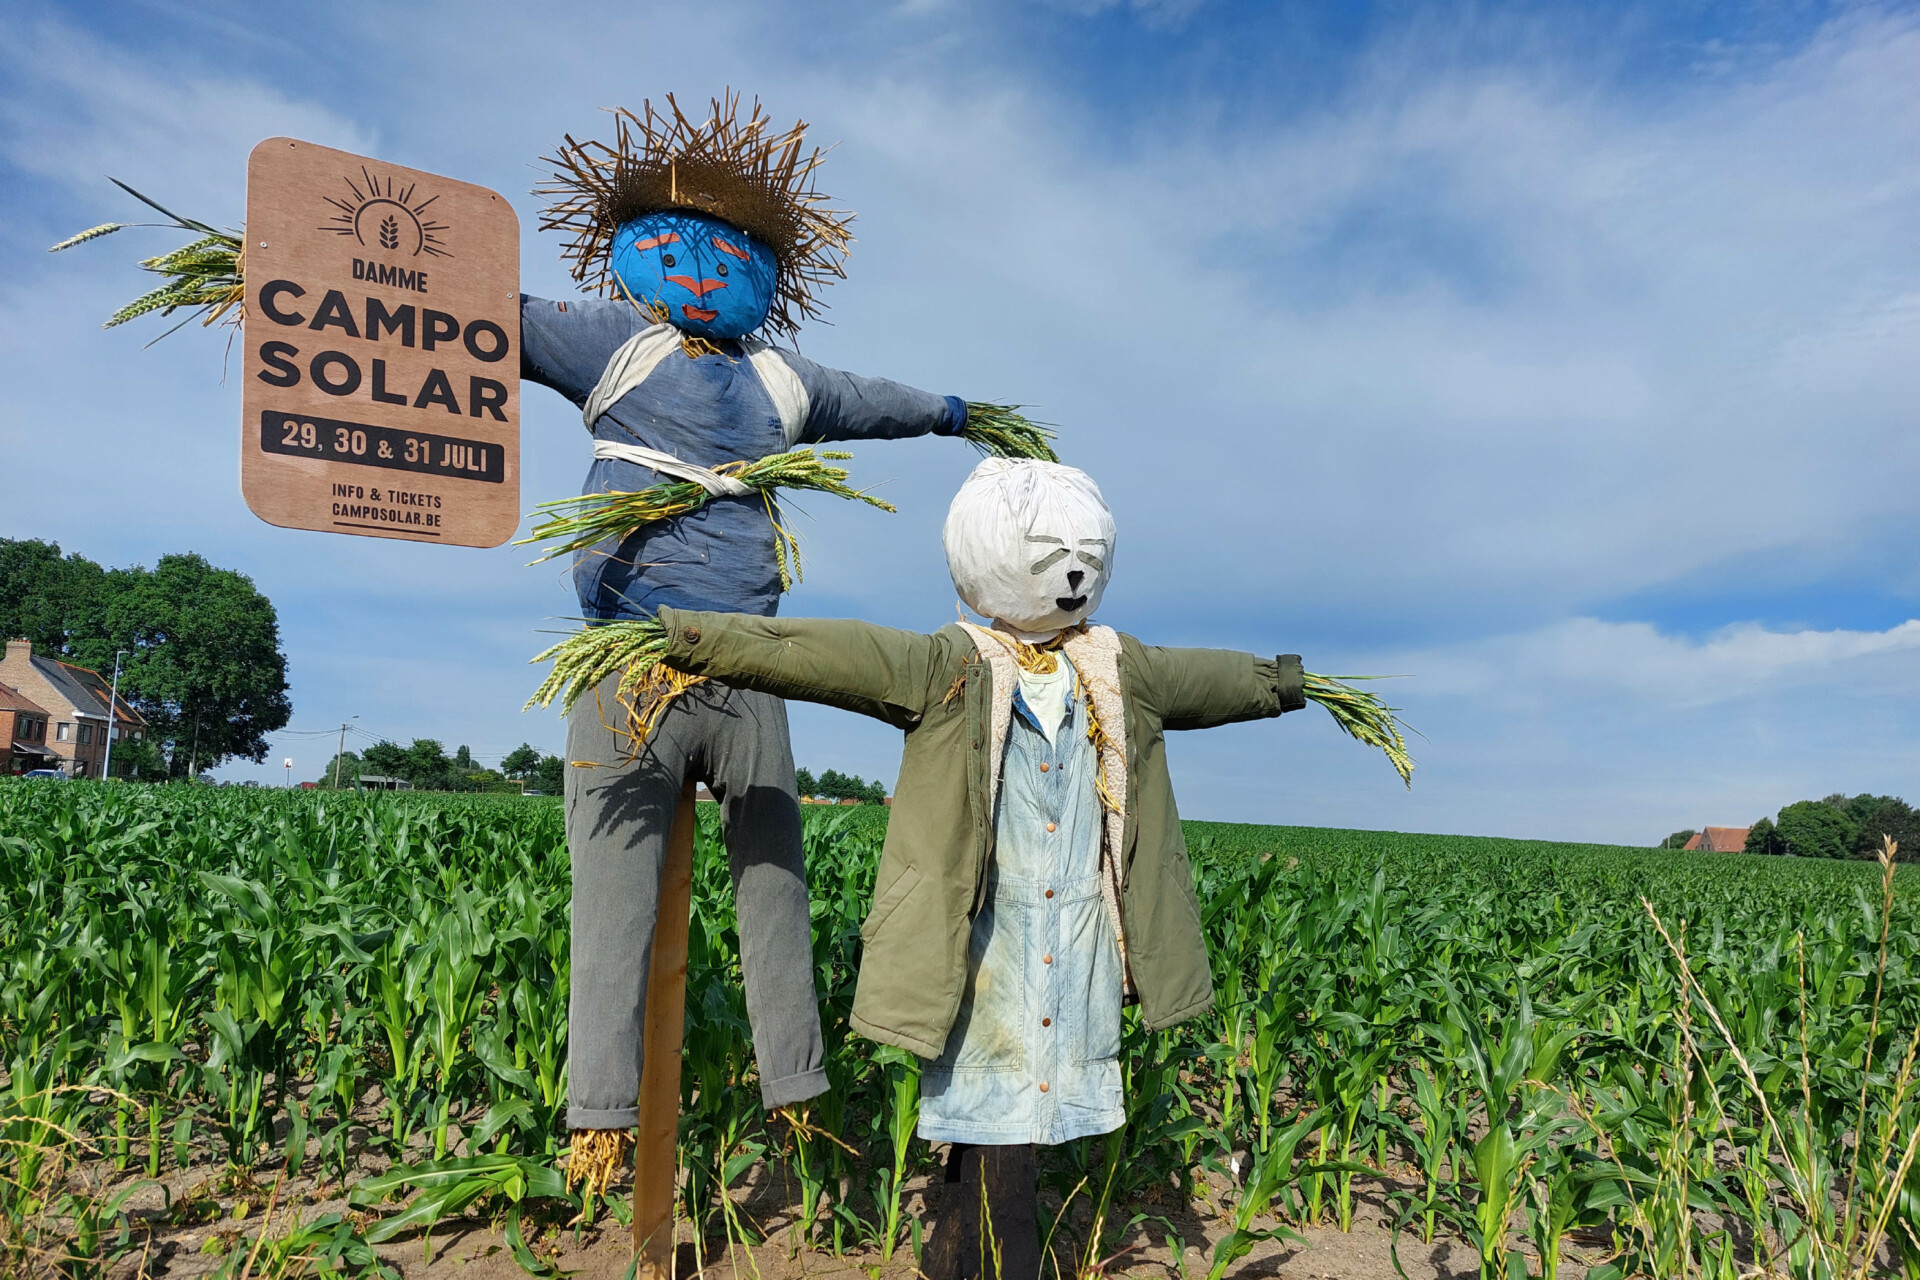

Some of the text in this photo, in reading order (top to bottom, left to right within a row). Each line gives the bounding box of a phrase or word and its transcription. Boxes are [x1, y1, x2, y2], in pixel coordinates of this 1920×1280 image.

[353, 257, 428, 293] DAMME
[258, 279, 509, 363] CAMPO
[257, 341, 509, 422] SOLAR
[281, 420, 487, 472] 29, 30 & 31 JULI
[332, 483, 442, 509] INFO & TICKETS
[332, 503, 441, 527] CAMPOSOLAR.BE
